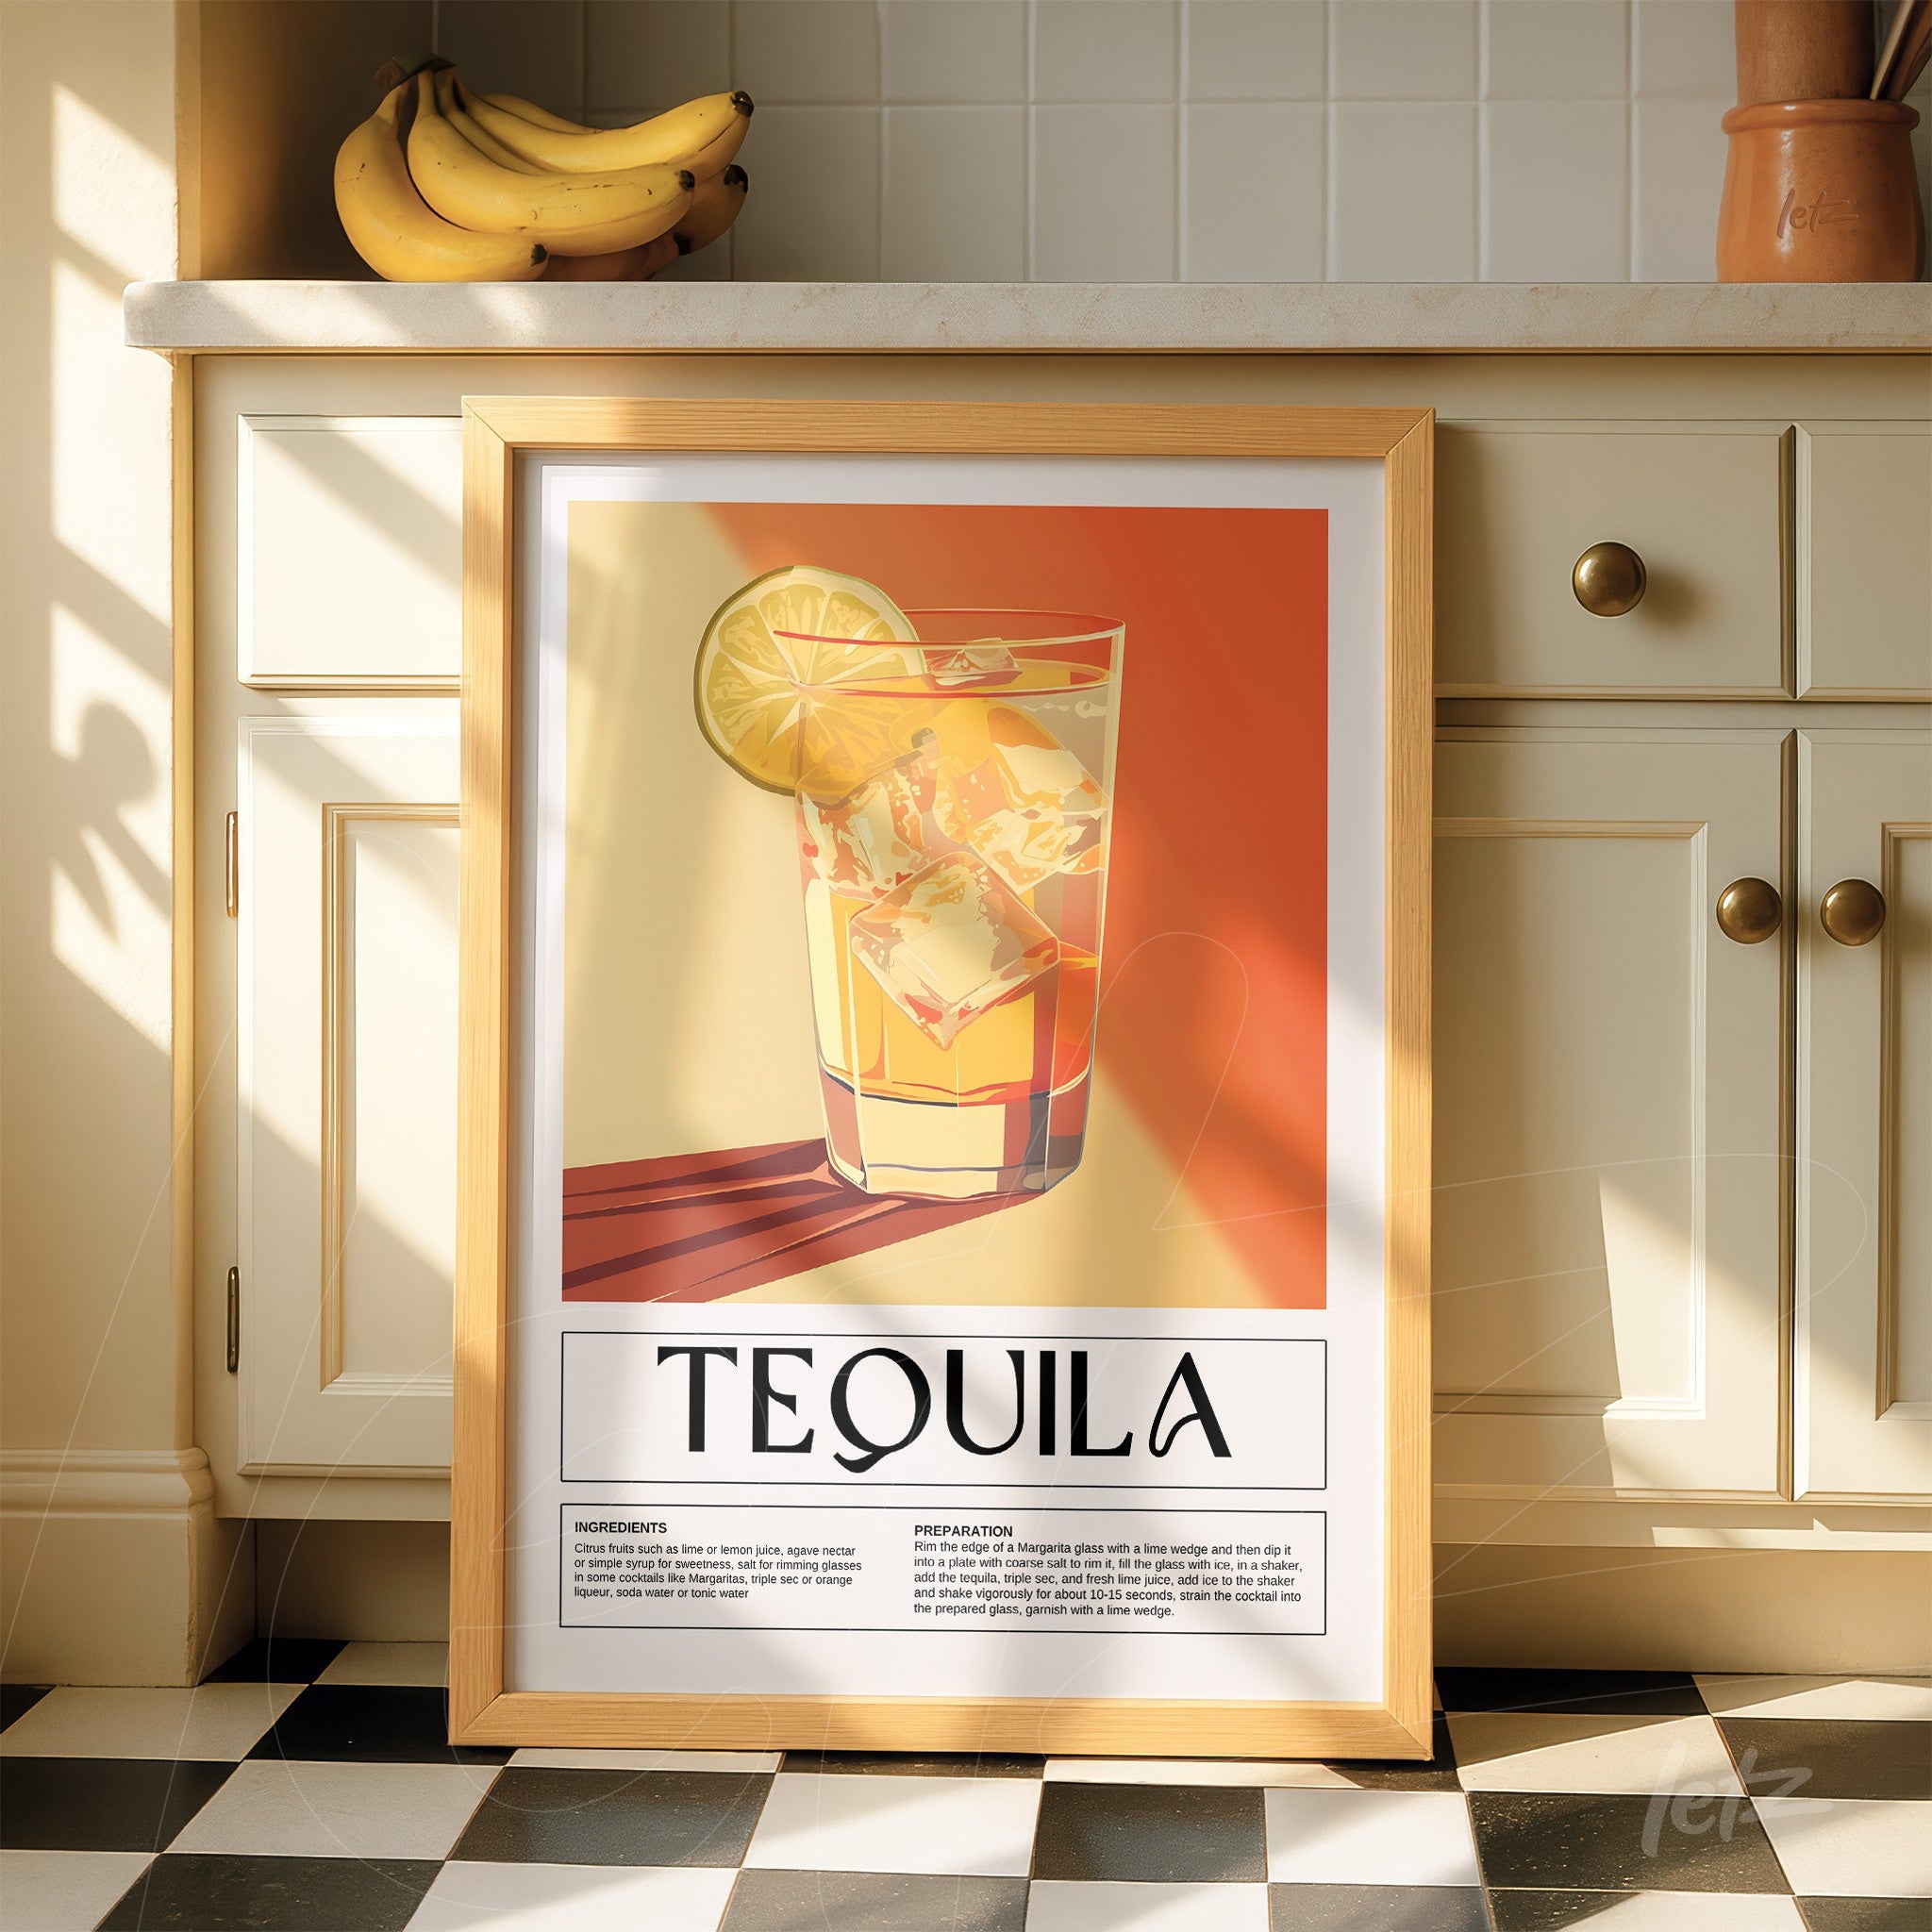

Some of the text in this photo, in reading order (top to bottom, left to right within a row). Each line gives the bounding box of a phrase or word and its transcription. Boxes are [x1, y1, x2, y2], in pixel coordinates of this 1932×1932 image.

[658, 1347, 1231, 1473] TEQUILA
[575, 1522, 667, 1534] INGREDIENTS
[915, 1524, 1012, 1537] PREPARATION
[575, 1542, 856, 1558] Citrus fruits such as lime or lemon juice, agave nectar
[915, 1541, 1291, 1558] Rim the edge of a Margarita glass with a lime wedge and then dip it
[575, 1557, 861, 1573] or simple syrup for sweetness, salt for rimming glasses
[914, 1557, 1302, 1573] into a plate with coarse salt to rim it, fill the glass with ice, in a shaker,
[575, 1572, 853, 1588] in some cocktails like Margaritas, triple sec or orange
[914, 1572, 1295, 1588] add the tequila, triple sec, and fresh lime juice, add ice to the shaker
[575, 1587, 749, 1599] liqueur, soda water or tonic water
[914, 1587, 1301, 1602] and shake vigorously for about 10-15 seconds, strain the cocktail into
[914, 1603, 1174, 1619] the prepared glass, garnish with a lime wedge.
